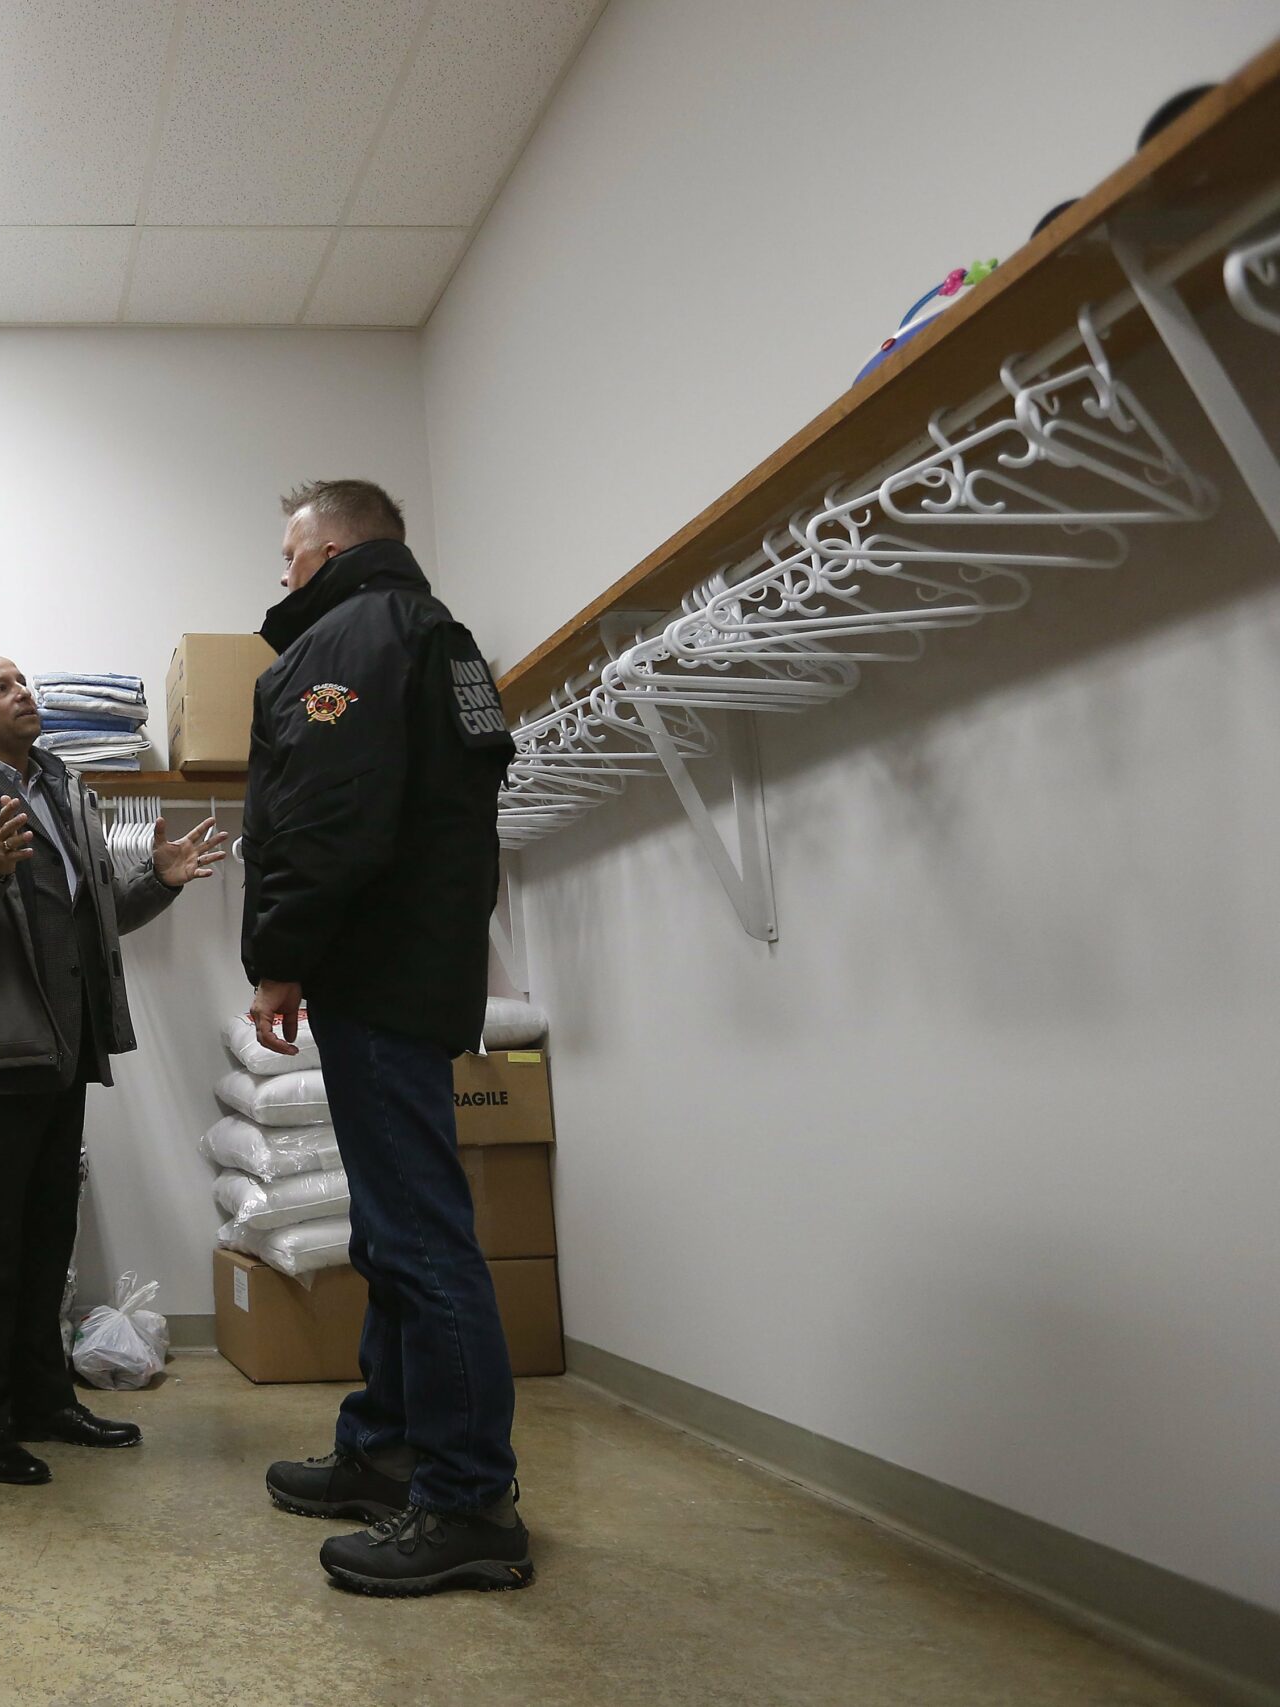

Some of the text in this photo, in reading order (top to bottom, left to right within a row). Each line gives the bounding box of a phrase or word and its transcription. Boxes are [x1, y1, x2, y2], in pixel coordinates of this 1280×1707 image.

[313, 683, 349, 694] EMERSON
[453, 684, 499, 710] EME
[459, 708, 506, 735] COO
[453, 1091, 508, 1106] RAGILE
